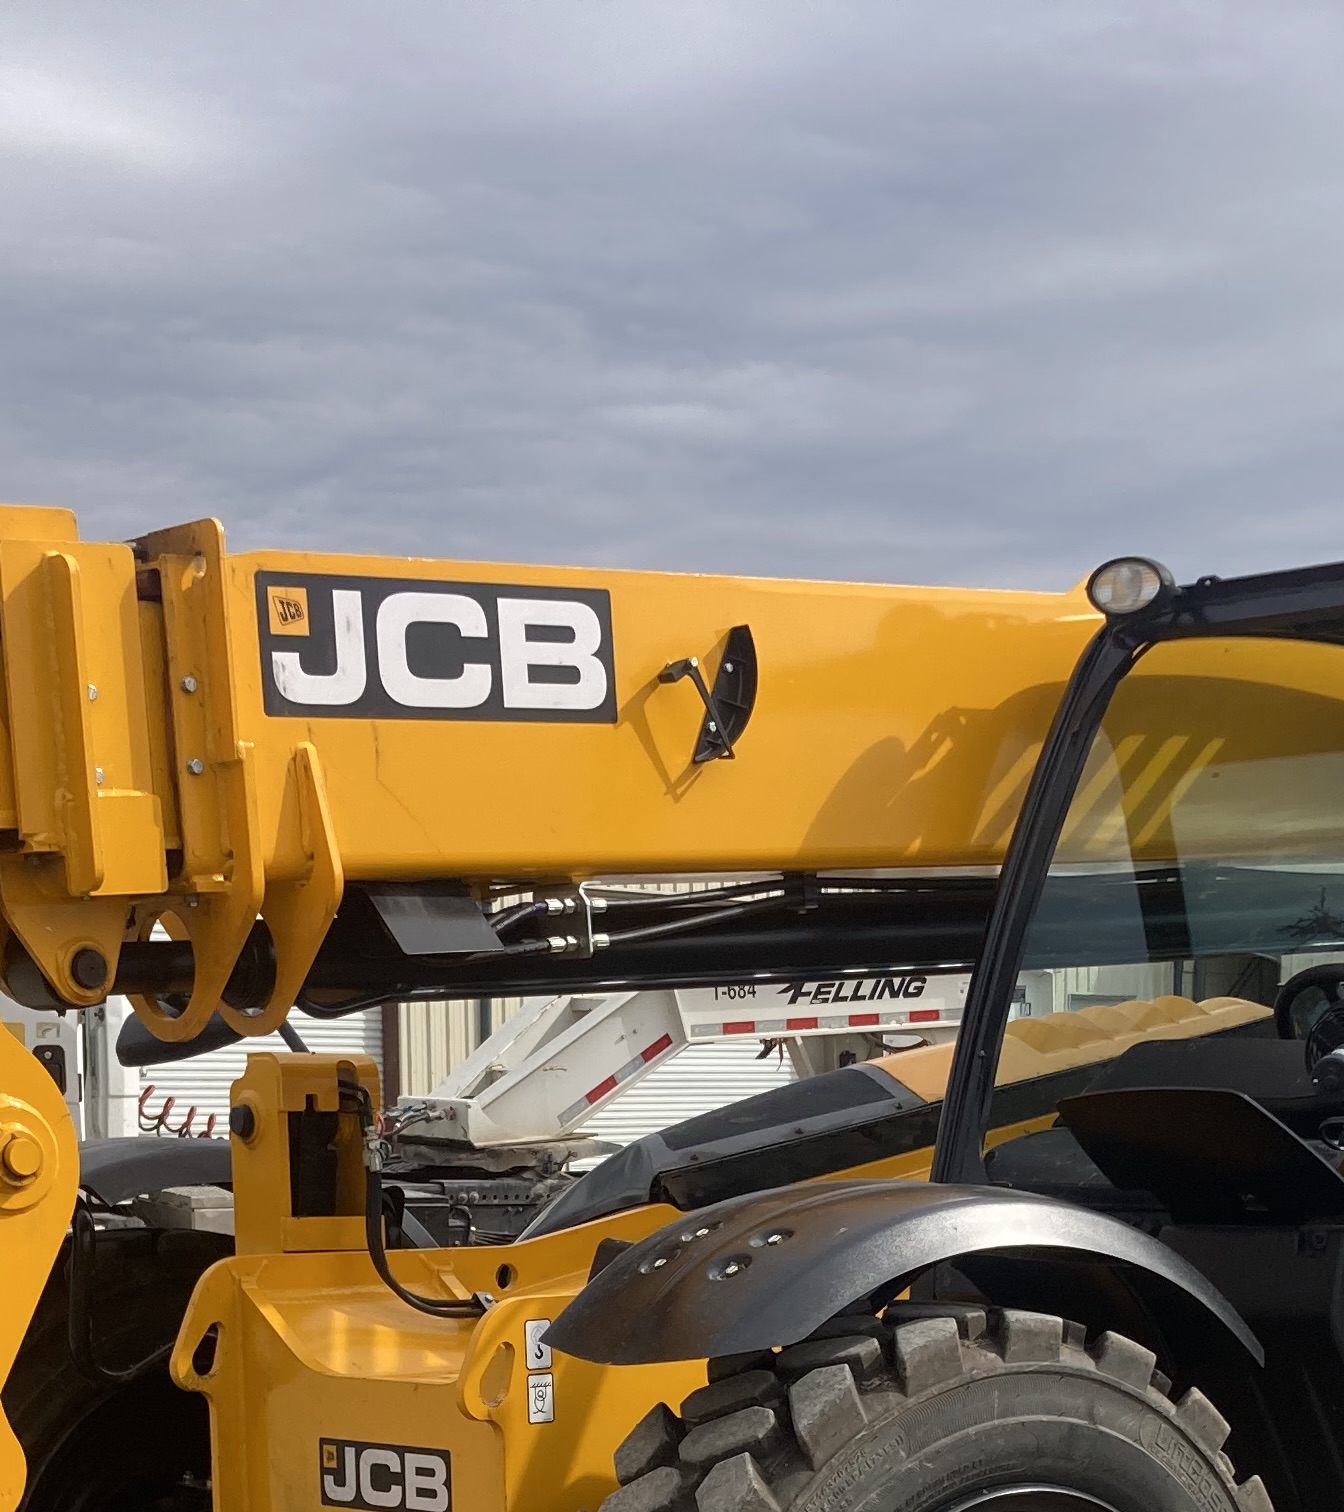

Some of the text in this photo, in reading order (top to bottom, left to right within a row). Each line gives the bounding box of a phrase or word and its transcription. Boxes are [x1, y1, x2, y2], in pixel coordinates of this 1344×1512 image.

[278, 599, 302, 622] JCB
[271, 588, 608, 709] JCB
[776, 976, 927, 1006] FELLING
[323, 1446, 449, 1512] JCB
